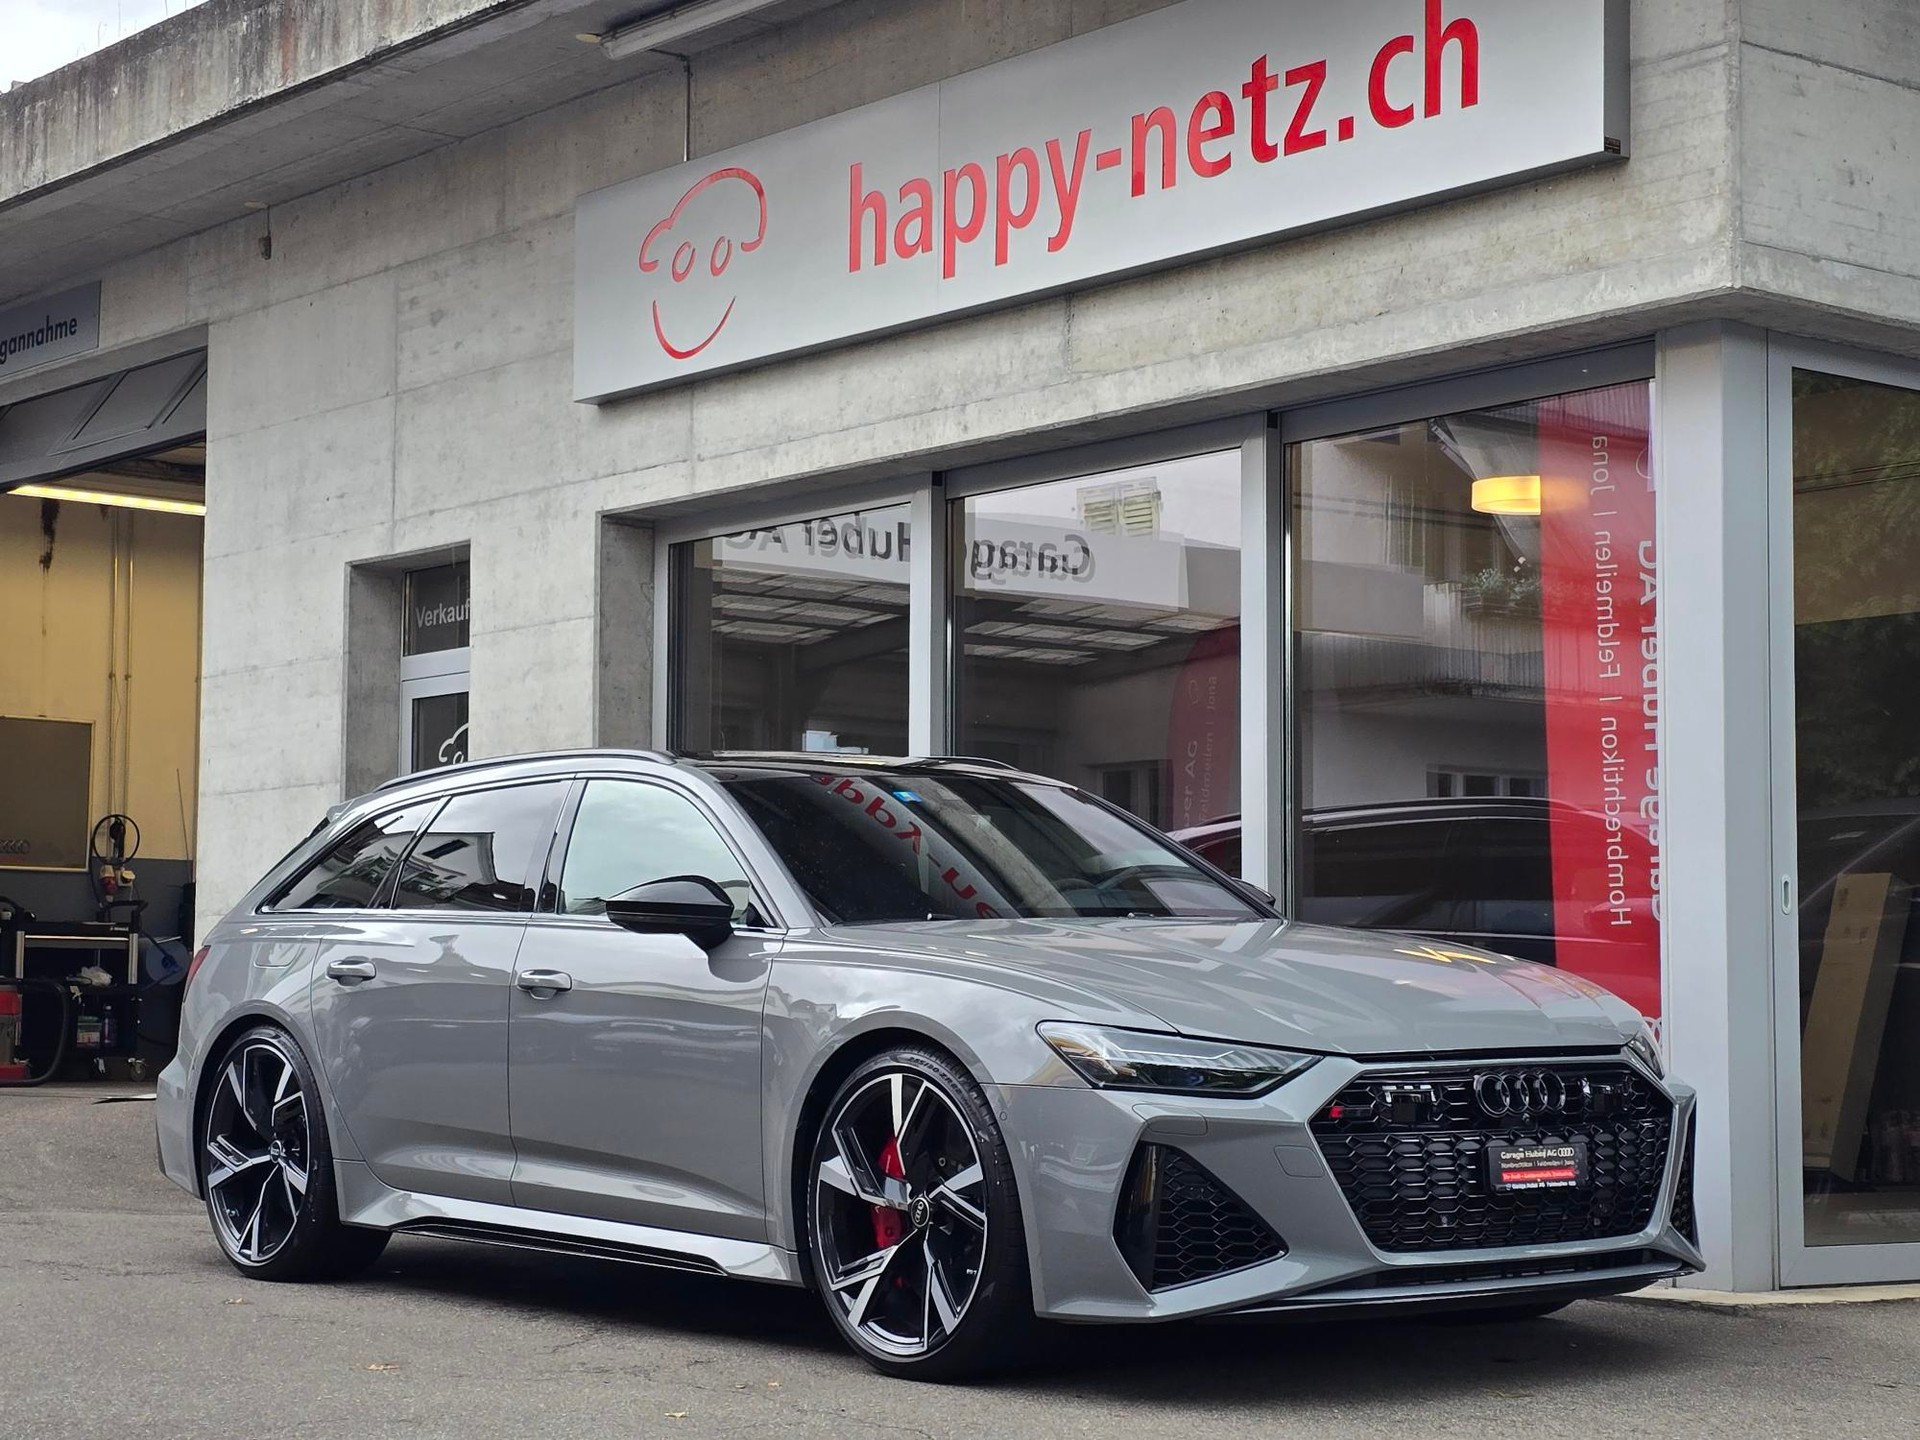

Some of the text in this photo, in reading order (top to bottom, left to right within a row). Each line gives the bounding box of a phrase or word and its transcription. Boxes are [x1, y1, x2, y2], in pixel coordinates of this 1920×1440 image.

[849, 0, 1479, 279] happy-netz.ch
[0, 315, 78, 364] gannahme
[415, 598, 470, 628] Verkauf
